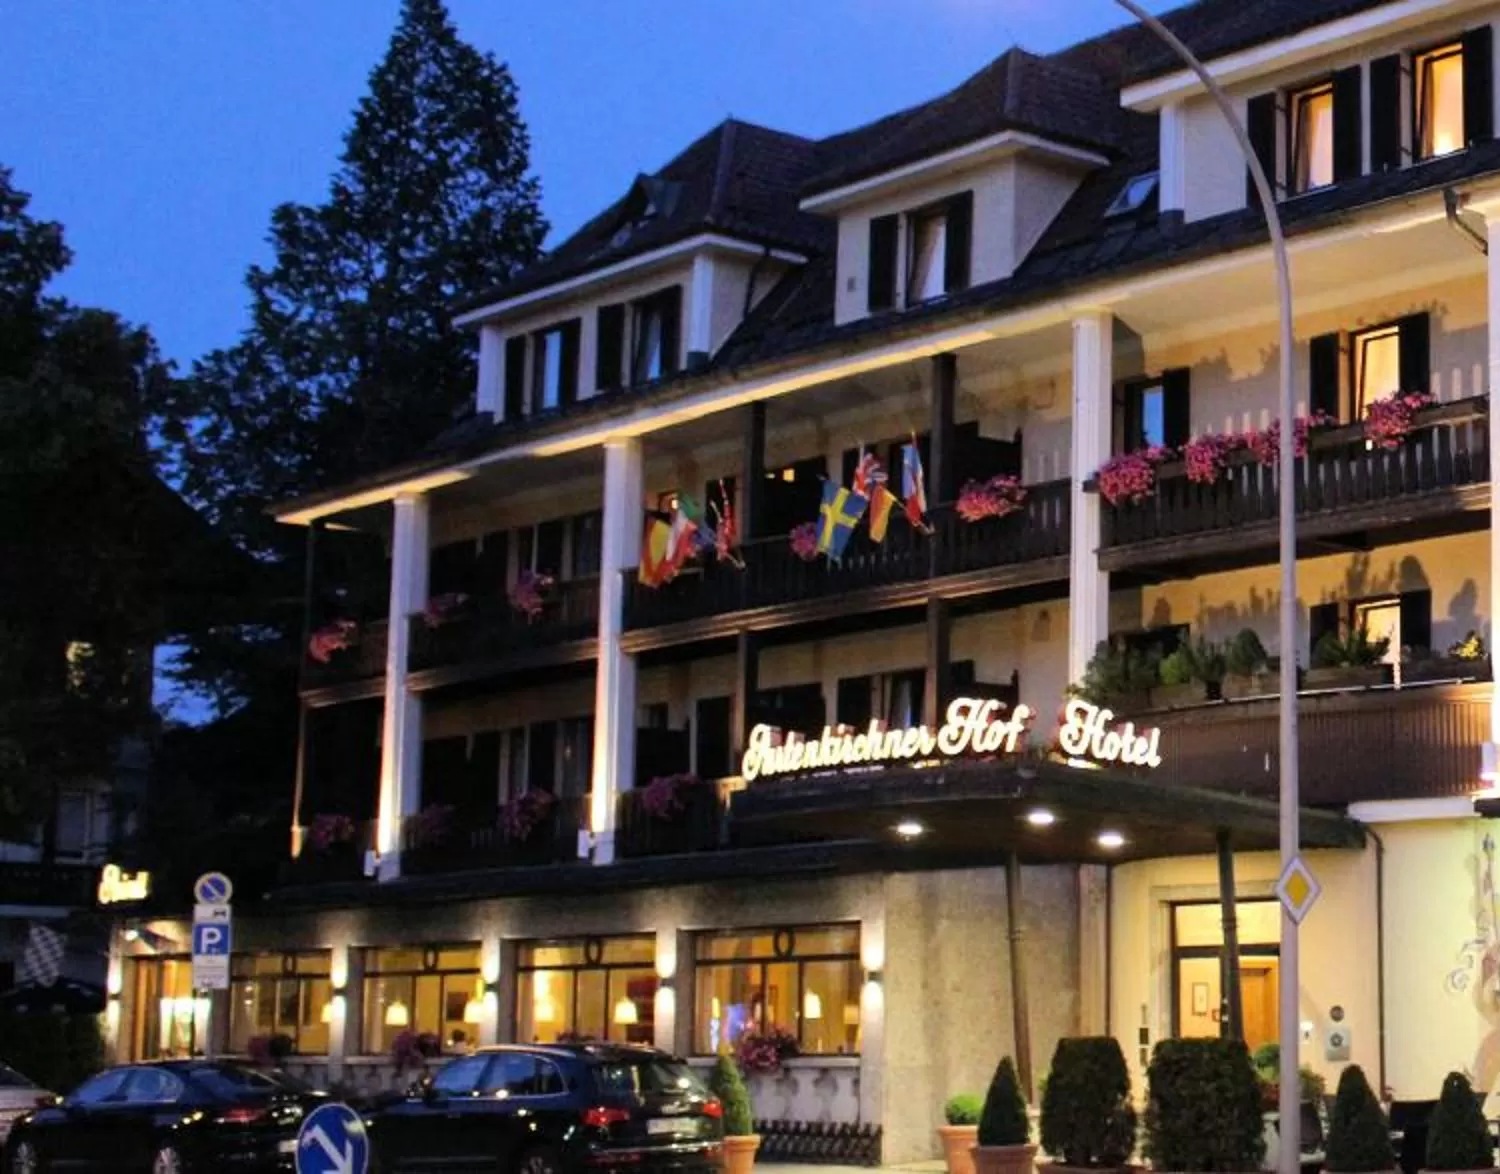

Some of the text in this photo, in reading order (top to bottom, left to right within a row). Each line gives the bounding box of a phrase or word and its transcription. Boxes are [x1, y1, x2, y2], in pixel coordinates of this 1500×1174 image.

[938, 697, 1031, 755] Hof
[1059, 699, 1162, 768] Hotel
[200, 926, 222, 954] P
